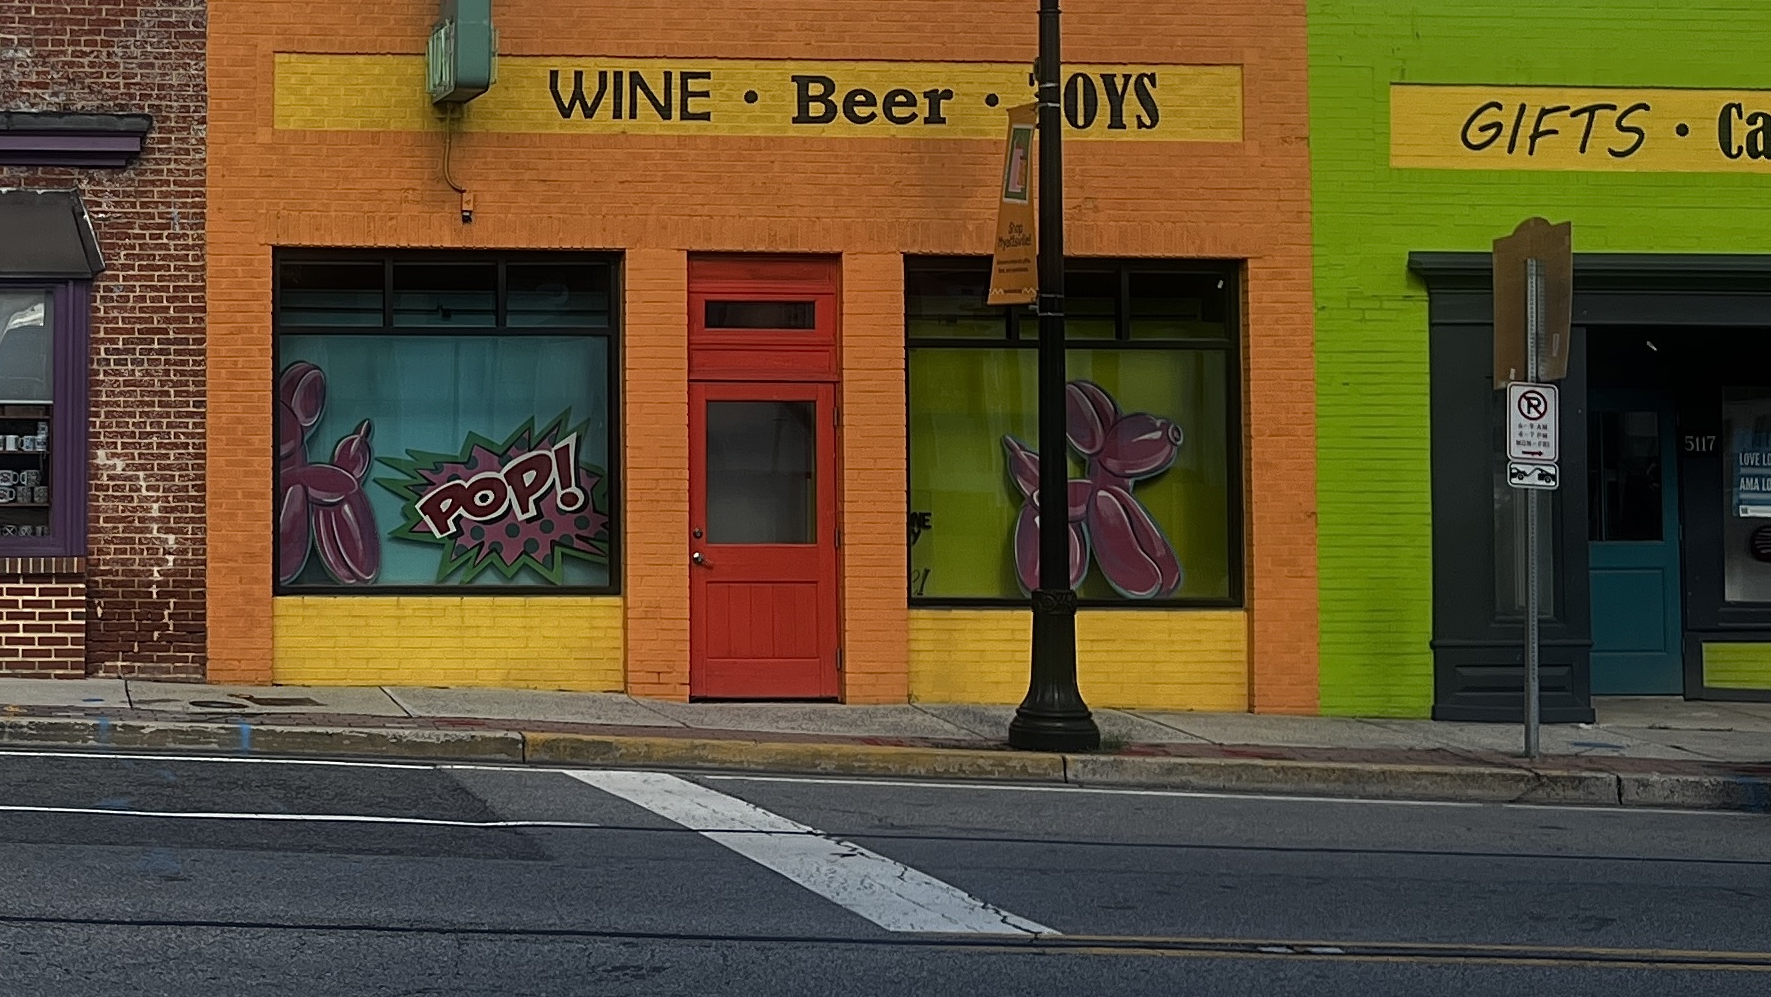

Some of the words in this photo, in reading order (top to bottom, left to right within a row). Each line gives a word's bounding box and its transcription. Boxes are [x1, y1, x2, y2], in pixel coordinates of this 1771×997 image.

[548, 69, 712, 121] WINE
[791, 74, 953, 125] Beer
[1029, 72, 1160, 130] OYS
[1460, 100, 1651, 158] GIFTS
[1684, 435, 1717, 452] 5117
[1739, 452, 1761, 466] LOVE
[415, 432, 585, 539] POP!
[1739, 477, 1760, 491] AMA
